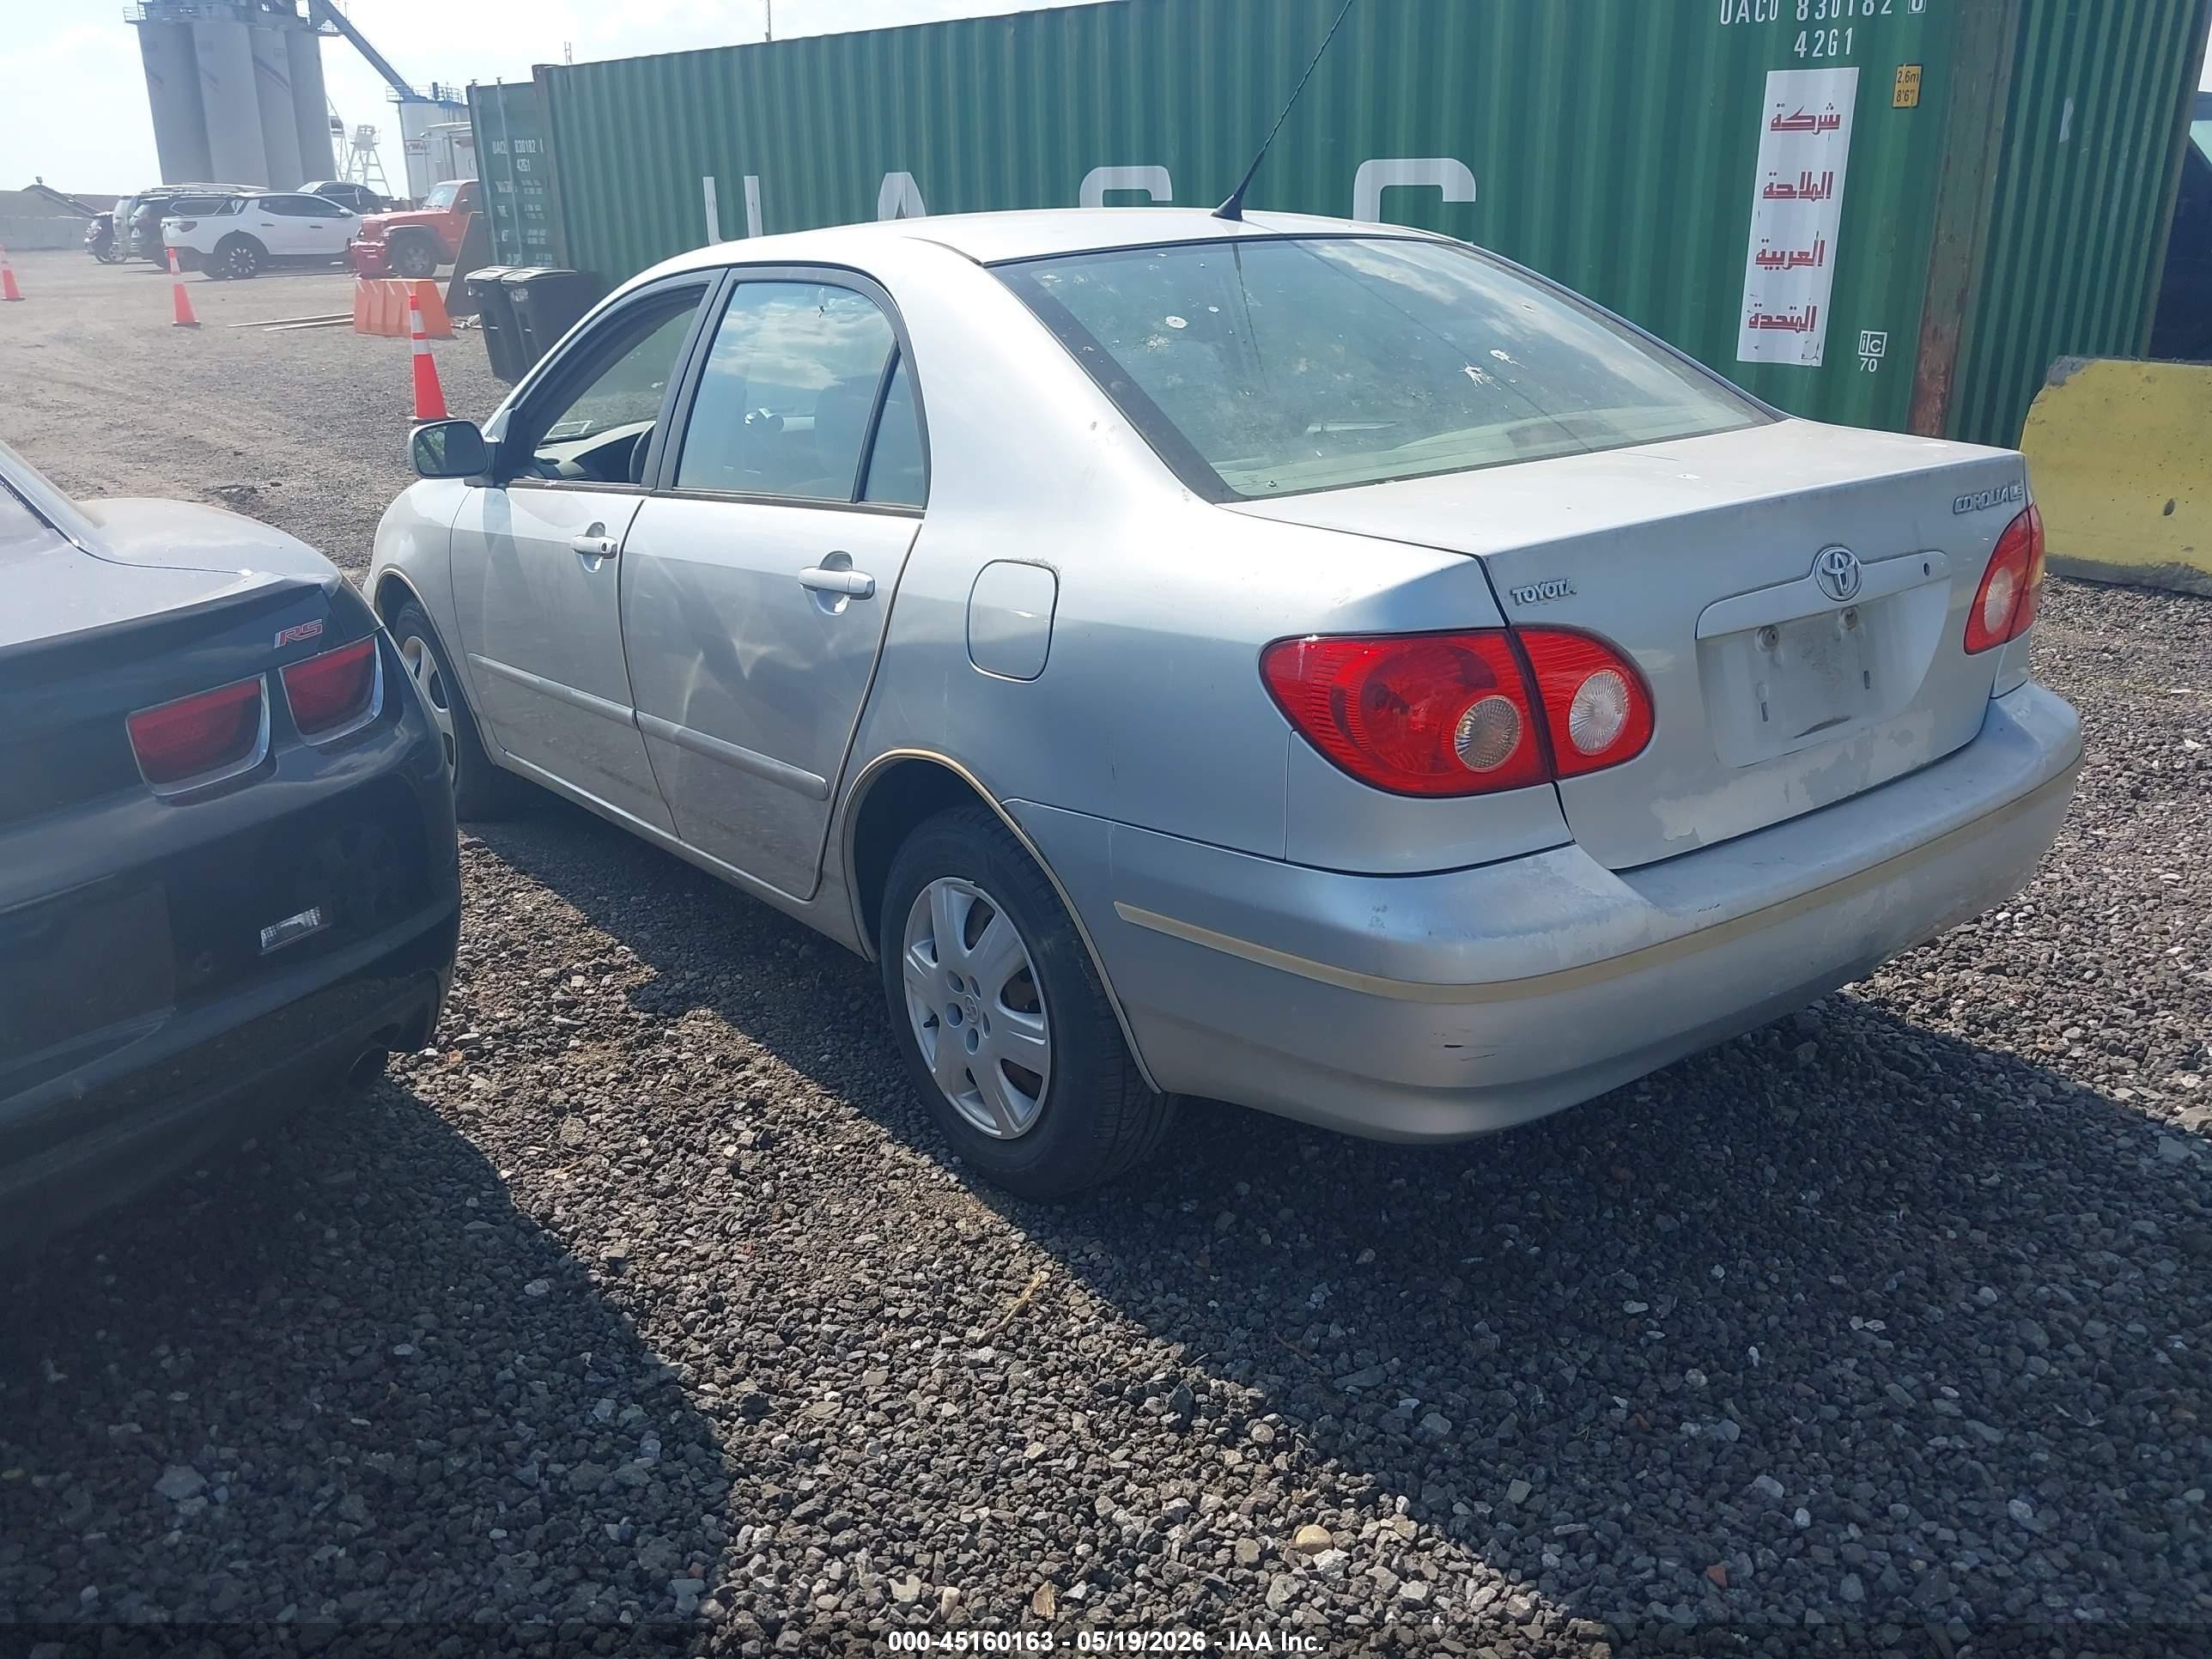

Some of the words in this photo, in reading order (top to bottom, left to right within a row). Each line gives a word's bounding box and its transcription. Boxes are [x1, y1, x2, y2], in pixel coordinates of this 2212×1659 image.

[1794, 27, 1853, 58] 42G1
[1770, 102, 1841, 136] شركة
[1762, 171, 1833, 203] الملاحة
[1755, 238, 1826, 270] العربية
[1748, 302, 1817, 334] المتحدة
[1860, 356, 1878, 373] 70
[1511, 579, 1577, 606] TOYOTA
[275, 618, 323, 648] RS
